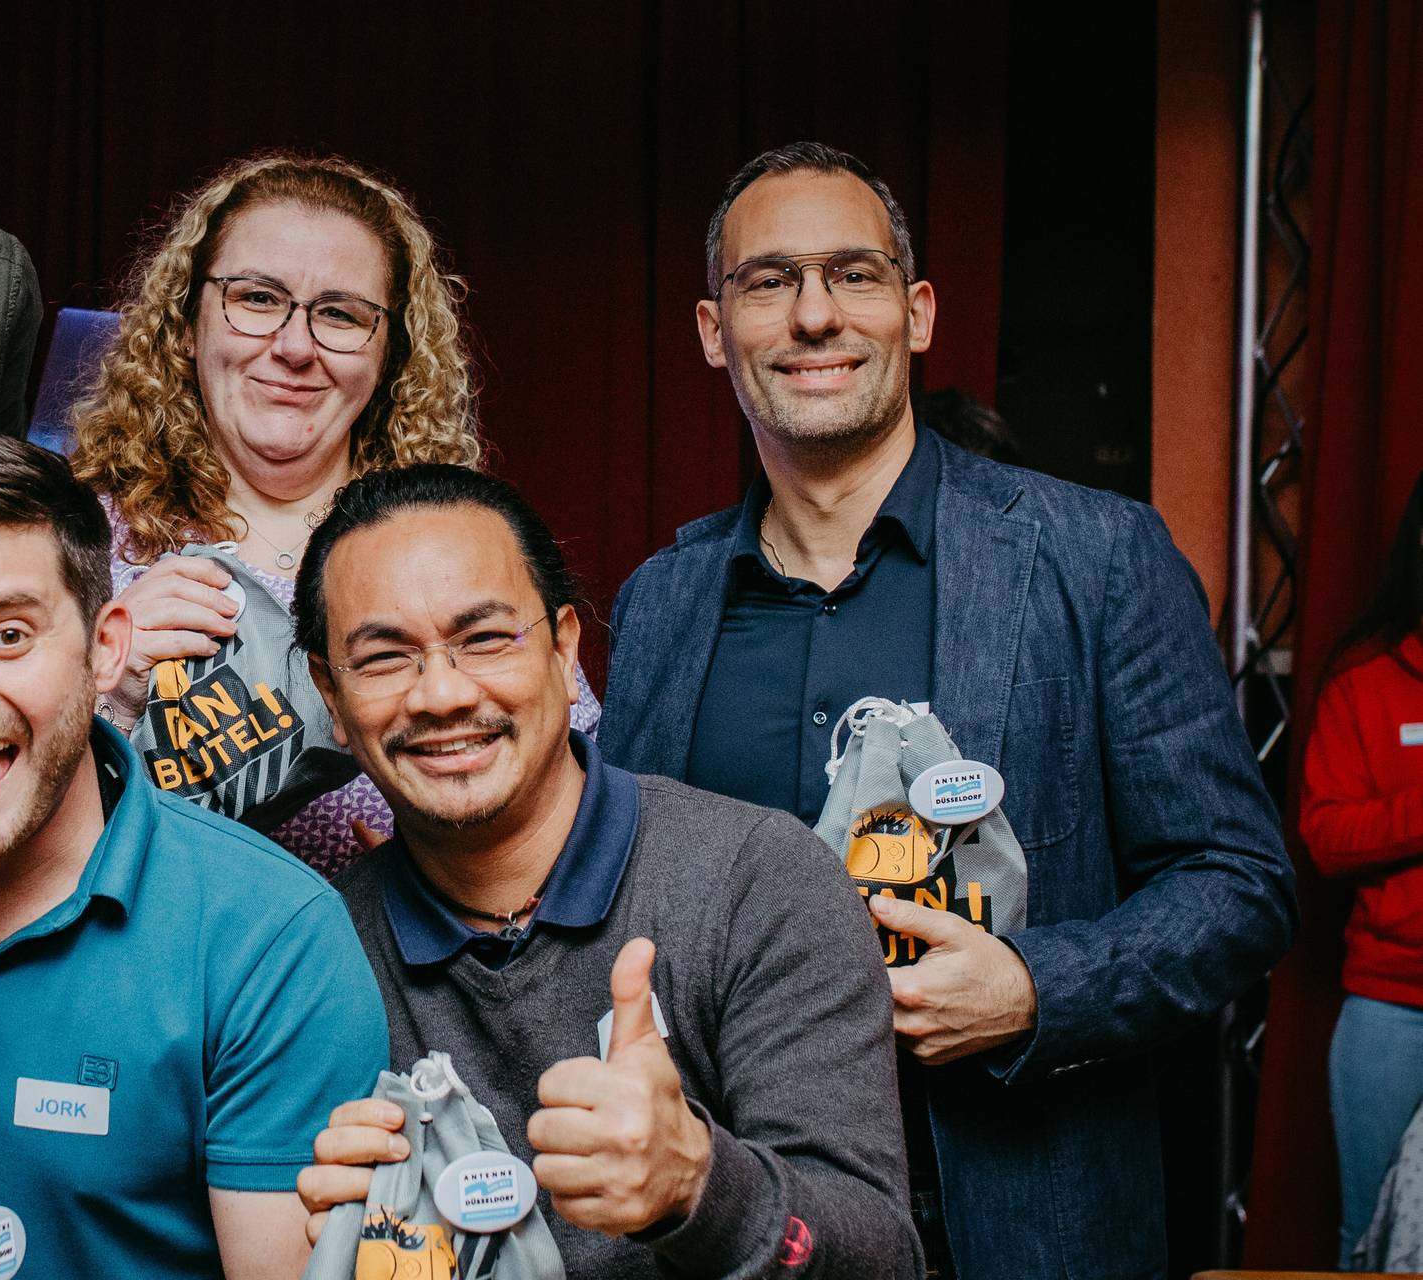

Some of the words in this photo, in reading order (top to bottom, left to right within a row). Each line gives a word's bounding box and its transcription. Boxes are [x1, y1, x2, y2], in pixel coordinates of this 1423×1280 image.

[935, 773, 981, 785] ANTENNE
[935, 793, 982, 805] DÜSSELDORF
[34, 1098, 87, 1119] JORK
